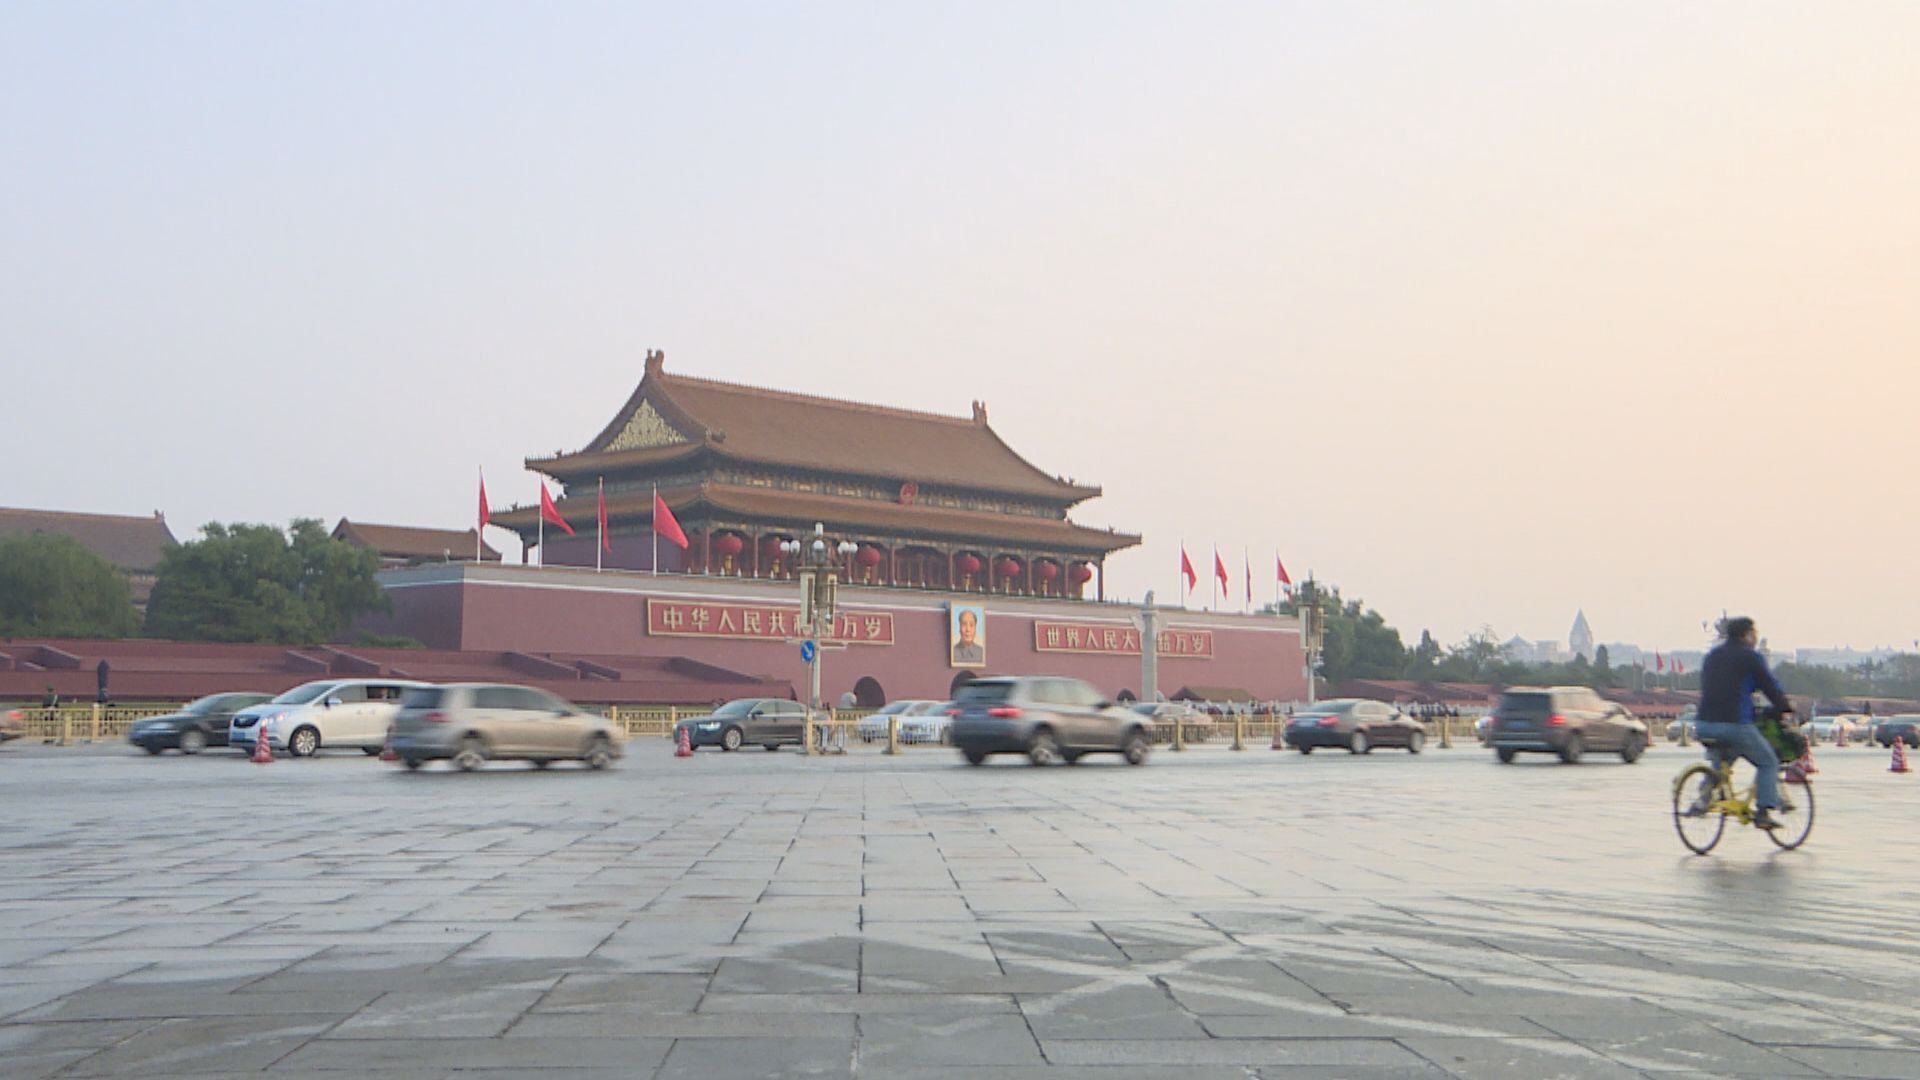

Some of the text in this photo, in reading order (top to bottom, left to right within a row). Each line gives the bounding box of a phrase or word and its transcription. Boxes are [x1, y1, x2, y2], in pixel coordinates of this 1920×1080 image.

[1047, 626, 1205, 653] 世界人民大结万岁
